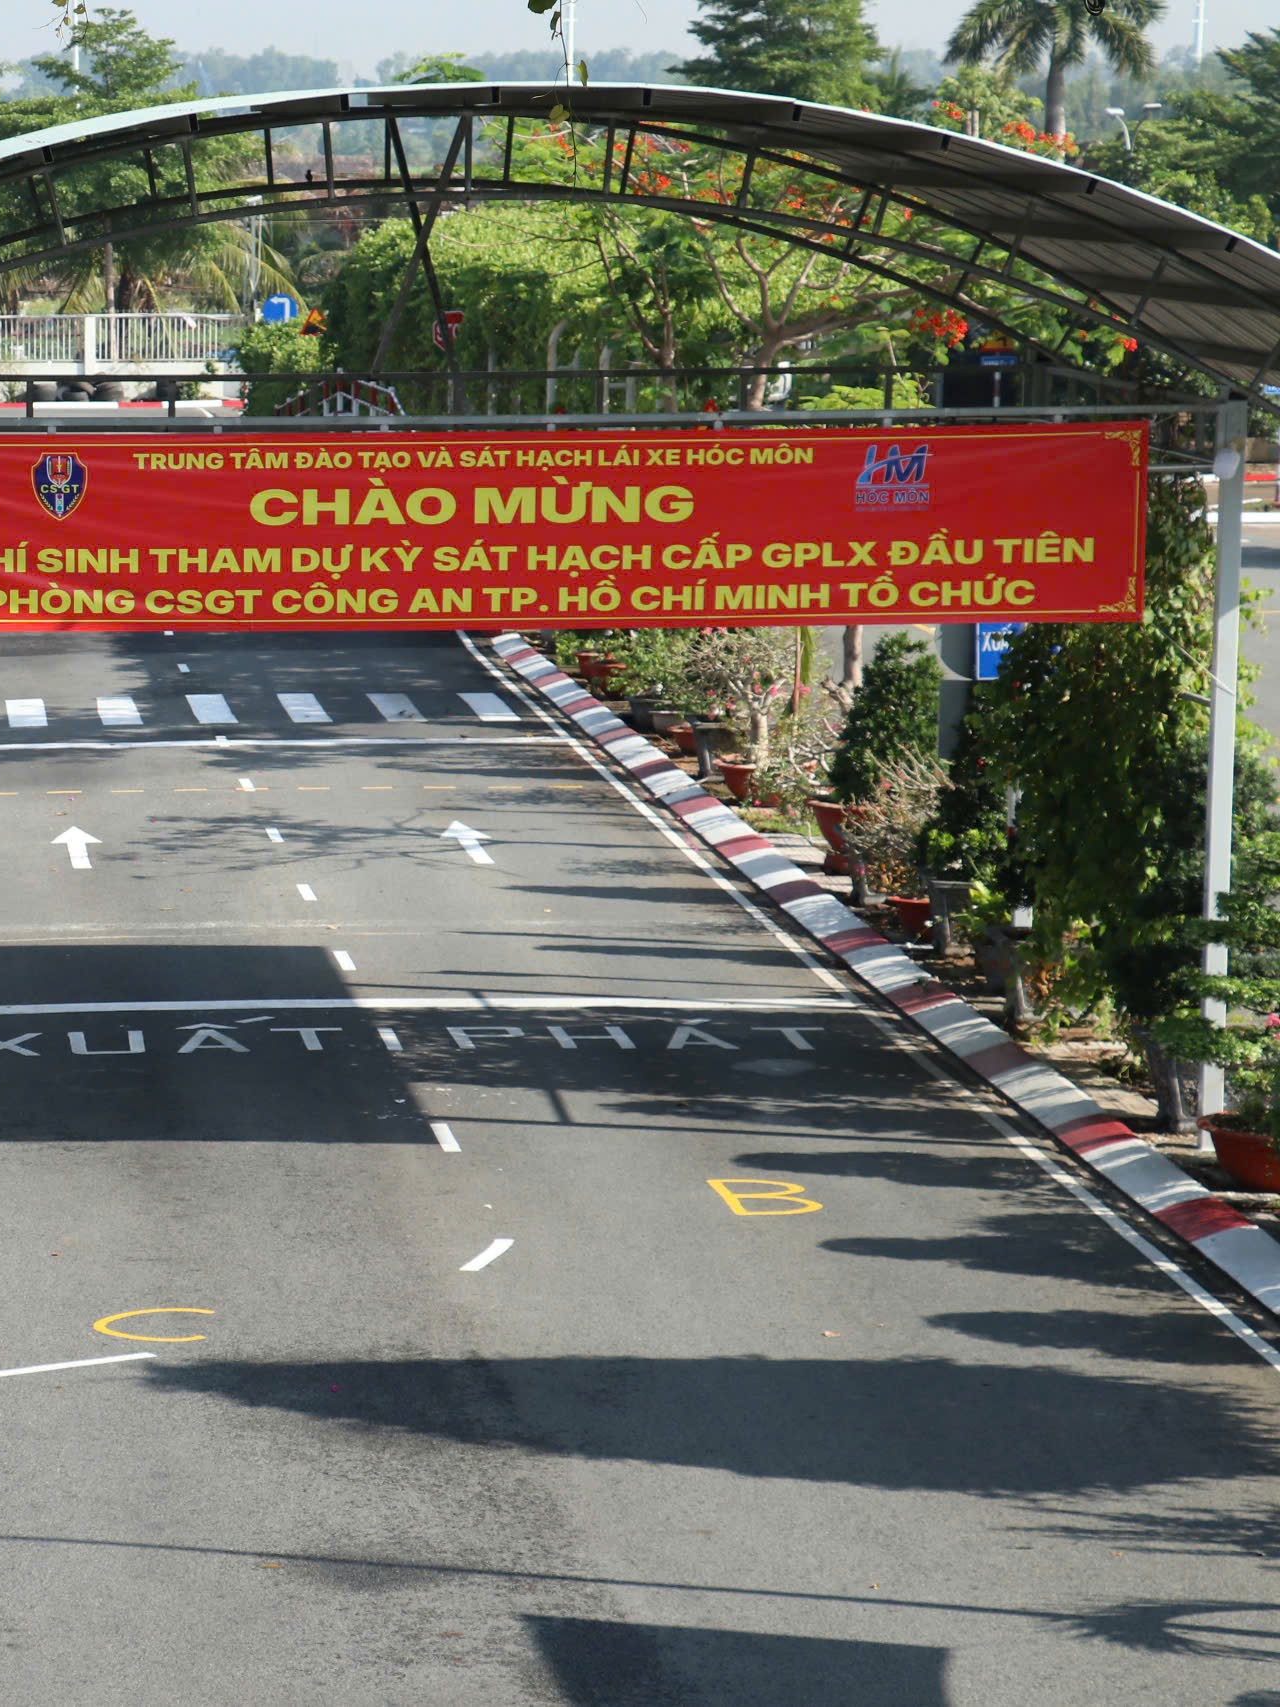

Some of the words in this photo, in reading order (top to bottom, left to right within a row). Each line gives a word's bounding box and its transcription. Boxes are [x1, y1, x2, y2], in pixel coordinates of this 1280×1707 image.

[132, 452, 223, 470] TRUNG
[230, 446, 288, 469] TÂM
[294, 445, 352, 469] ĐÀO
[357, 451, 411, 473] TẠO
[418, 445, 453, 468] VÀ
[459, 445, 511, 468] SÁT
[517, 449, 592, 472] HẠCH
[599, 444, 640, 467] LÁI
[647, 448, 681, 466] XE
[686, 443, 745, 466] HÓC
[750, 442, 814, 465] MÔN
[40, 484, 80, 494] CSGT
[249, 477, 457, 526] CHÀO
[473, 474, 694, 525] MỪNG
[36, 547, 139, 574] SINH
[148, 547, 281, 574] THAM
[292, 543, 354, 581] DỰ
[360, 539, 424, 572] KỲ
[433, 538, 518, 572] SÁT
[528, 544, 652, 578] HẠCH
[661, 531, 753, 570] CẤP
[761, 541, 877, 569] GPLX
[887, 527, 984, 566] ĐẦU
[993, 530, 1095, 564] TIÊN
[144, 588, 263, 615] CSGT
[271, 581, 399, 614] CÔNG
[408, 587, 473, 613] AN
[481, 587, 549, 613] TP.
[558, 574, 622, 612] HỒ
[630, 578, 706, 612] CHÍ
[714, 583, 830, 611] MINH
[839, 570, 899, 608] TỔ
[908, 573, 1035, 607] CHỨC
[445, 1018, 824, 1050] PHÁT
[706, 1179, 824, 1216] B
